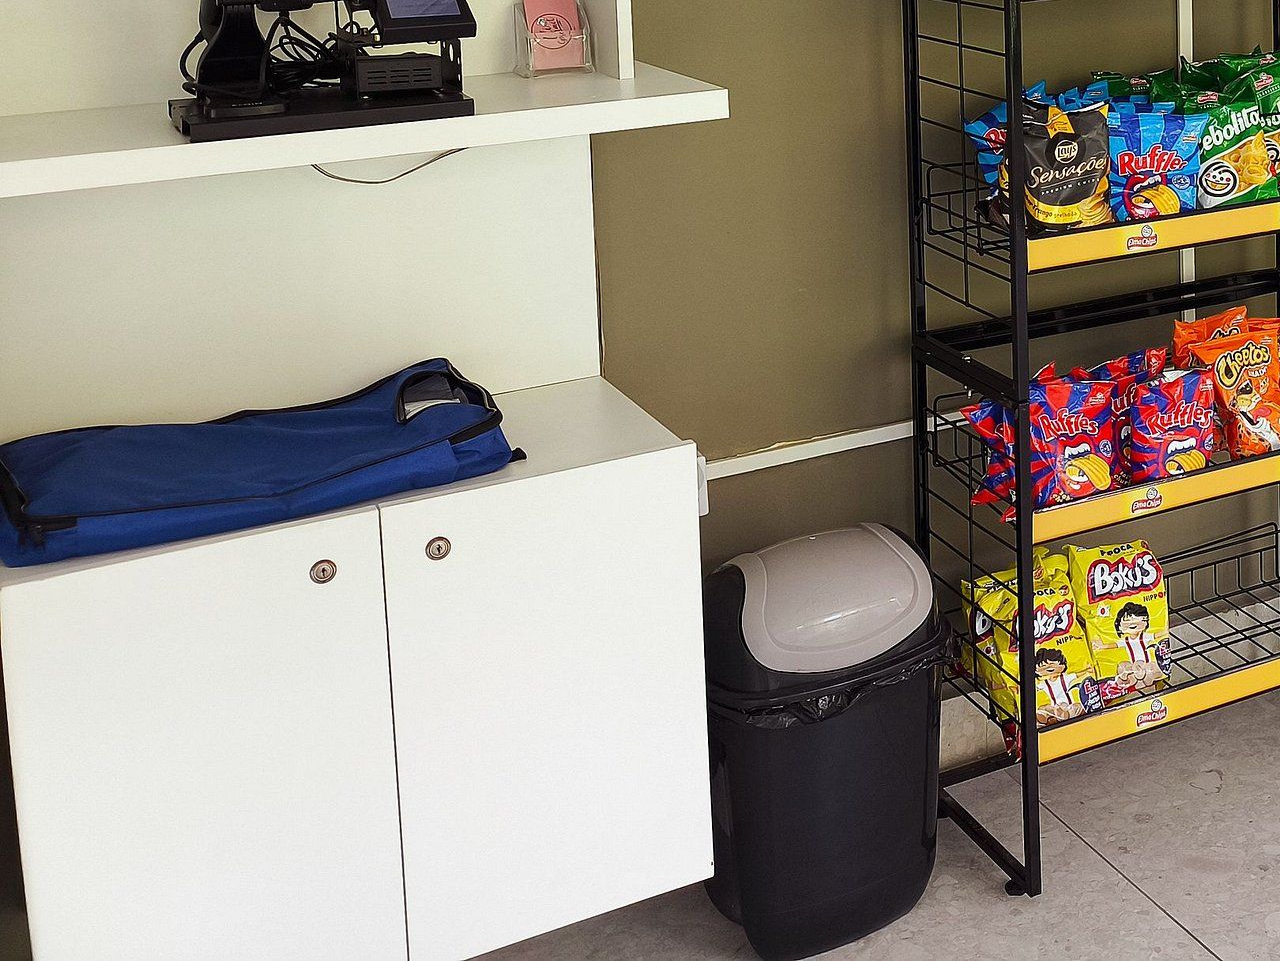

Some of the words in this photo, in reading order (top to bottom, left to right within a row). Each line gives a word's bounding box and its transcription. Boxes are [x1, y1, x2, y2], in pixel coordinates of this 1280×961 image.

[1215, 340, 1272, 389] Cheetos
[1038, 407, 1099, 442] Ruffles
[1146, 400, 1213, 435] Ruffles
